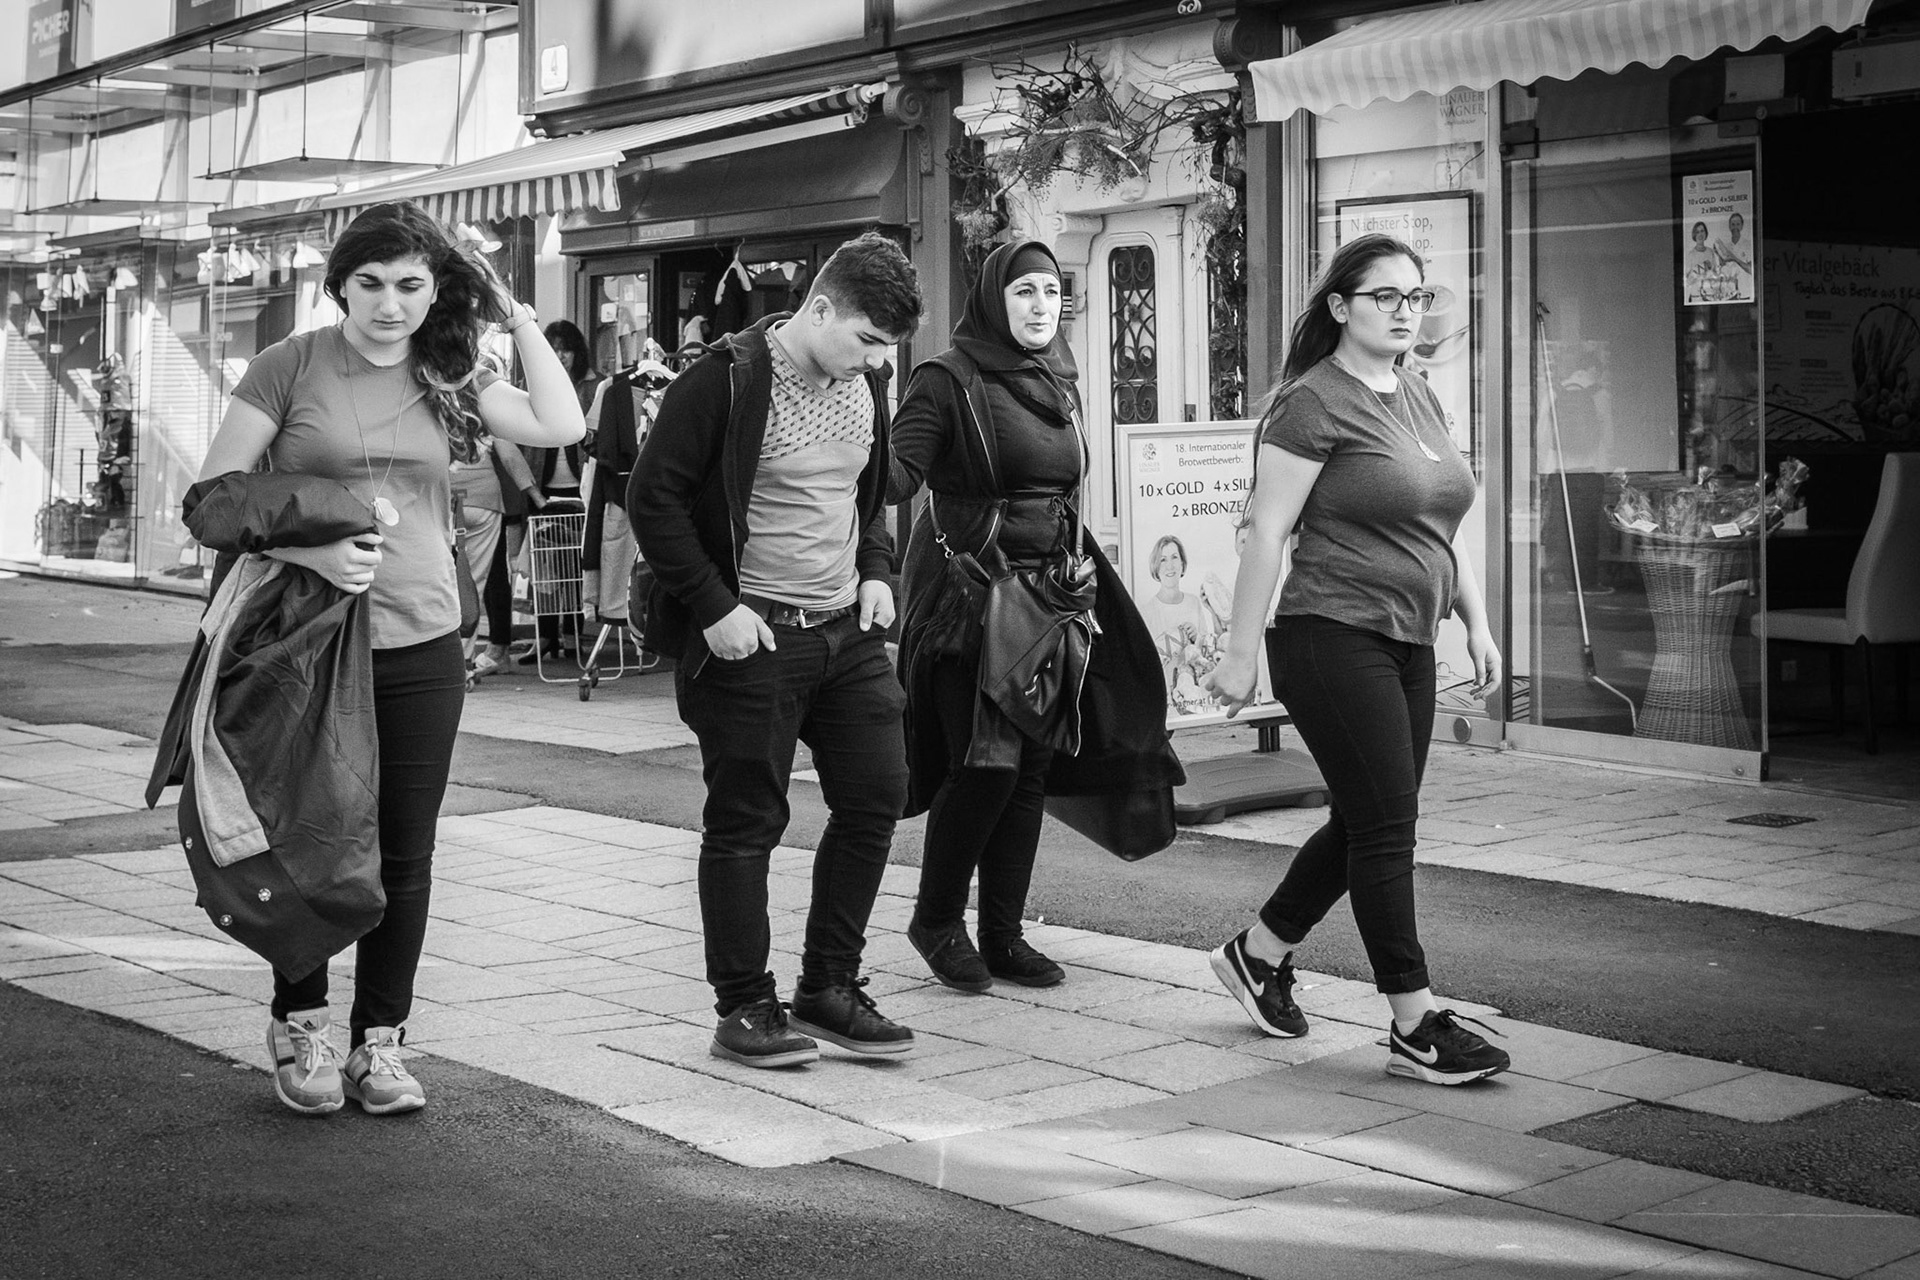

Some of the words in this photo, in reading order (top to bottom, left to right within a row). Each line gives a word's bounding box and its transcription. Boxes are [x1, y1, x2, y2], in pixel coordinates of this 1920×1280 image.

[1439, 102, 1486, 118] WAGNER
[1698, 197, 1717, 205] GOLD
[1728, 194, 1748, 202] SILBER
[1710, 205, 1734, 213] BRONZE
[1403, 214, 1433, 233] Sop,
[1783, 251, 1880, 282] Vitalgebäck
[1174, 444, 1187, 454] 18.
[1188, 441, 1247, 453] Internationaler
[1178, 454, 1244, 468] Brotwettbewerb:
[1165, 481, 1204, 496] GOLD
[1191, 500, 1244, 516] BRONZE
